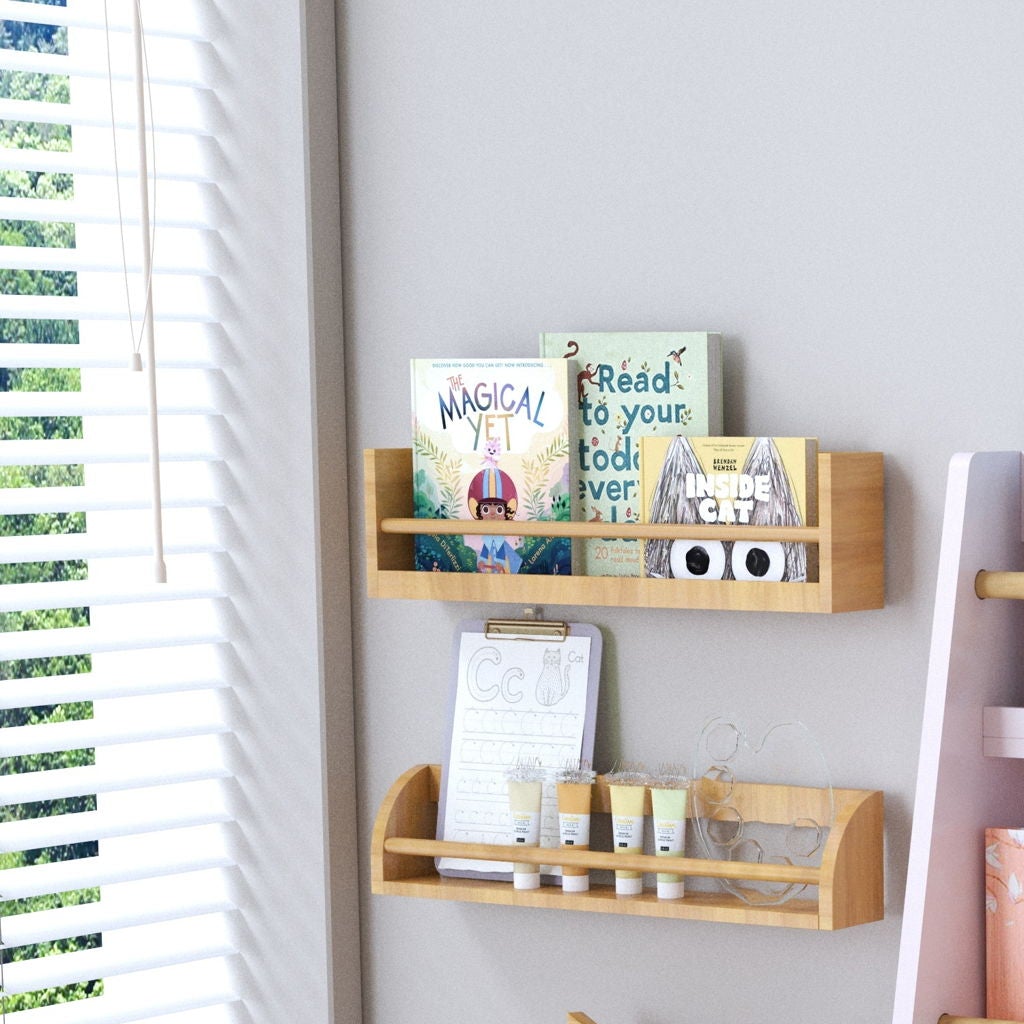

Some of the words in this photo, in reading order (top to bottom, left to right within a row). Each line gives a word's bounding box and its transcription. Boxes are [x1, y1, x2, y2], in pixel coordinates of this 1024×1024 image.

[446, 374, 465, 392] THE
[599, 361, 670, 394] Read
[438, 382, 545, 430] MAGICAL
[578, 398, 610, 426] to
[621, 404, 687, 435] your
[467, 413, 515, 451] YET
[685, 470, 771, 502] INSIDE
[699, 497, 754, 523] CAT
[594, 546, 609, 560] 20
[567, 651, 585, 664] Cat
